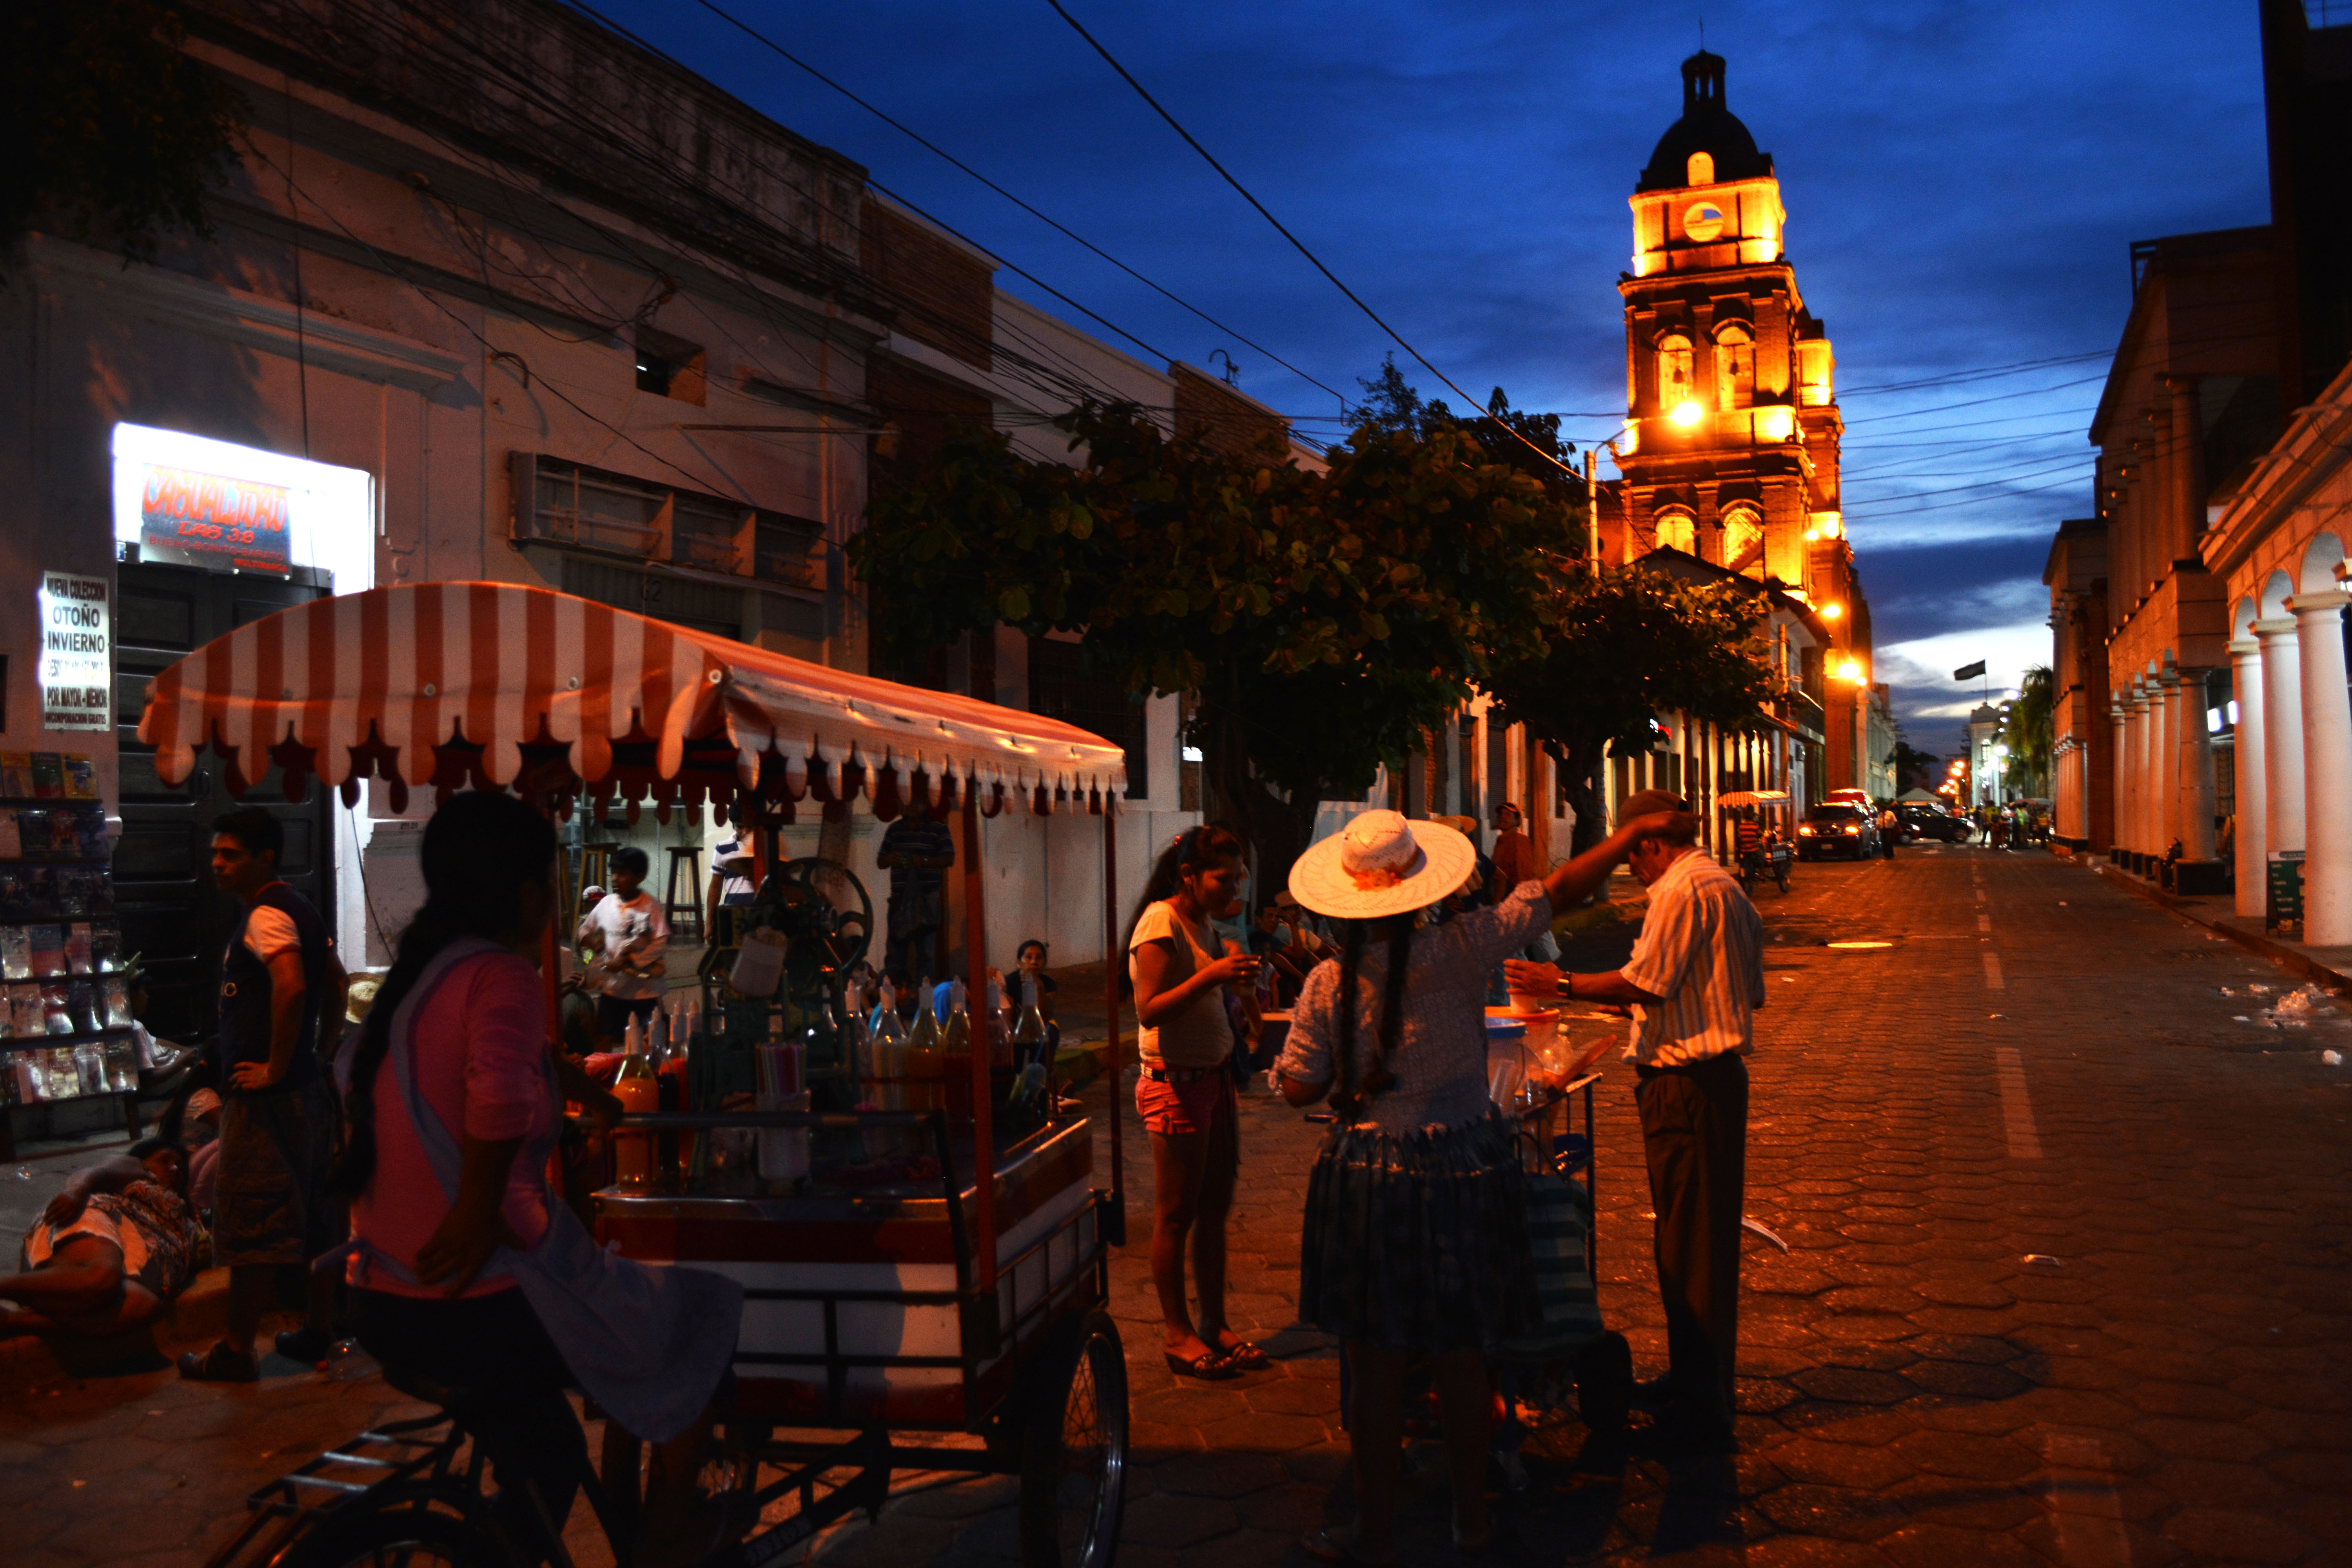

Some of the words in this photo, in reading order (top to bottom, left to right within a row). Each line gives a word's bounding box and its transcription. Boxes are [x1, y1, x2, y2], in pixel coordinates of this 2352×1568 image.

[143, 466, 288, 532] CASUALIDAD
[178, 521, 222, 539] LAS
[227, 528, 254, 544] 3B
[53, 603, 100, 628] OTOÑO
[48, 631, 105, 653] INVIERNO
[47, 686, 60, 706] POR
